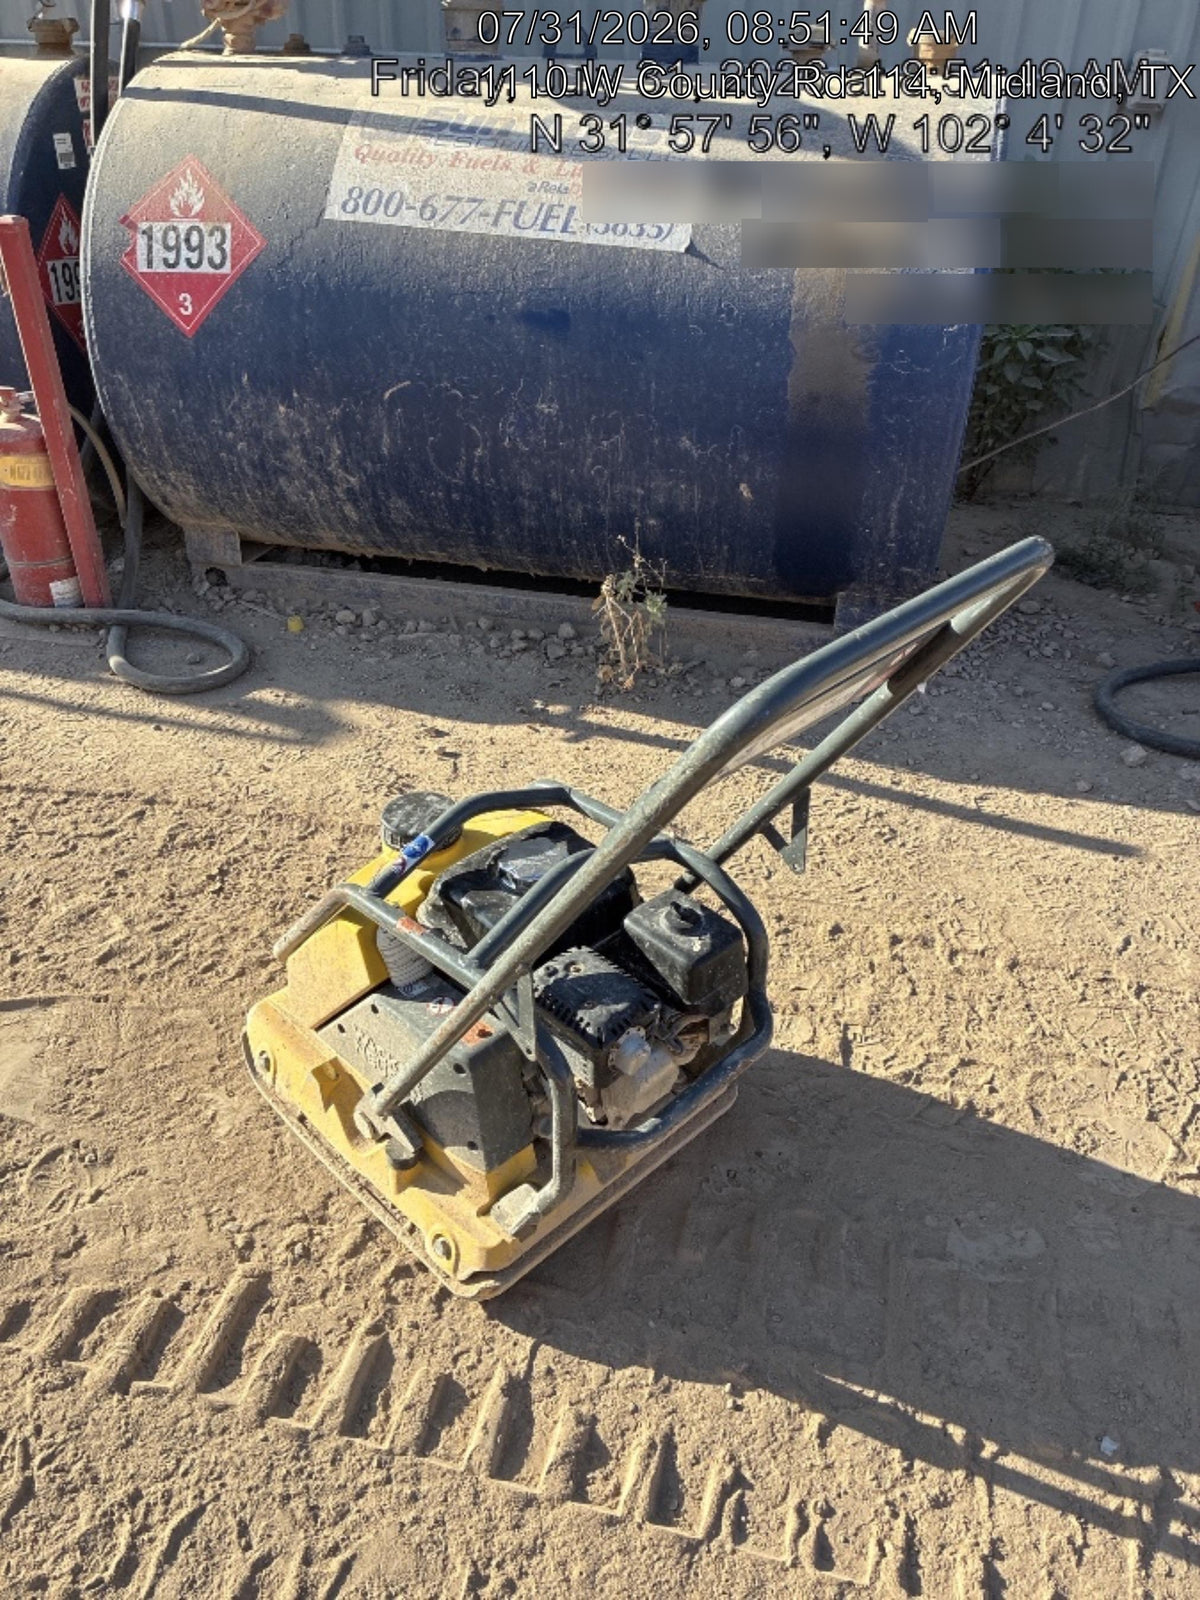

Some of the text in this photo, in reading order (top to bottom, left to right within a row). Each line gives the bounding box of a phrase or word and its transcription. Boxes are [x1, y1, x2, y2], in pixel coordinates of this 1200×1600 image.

[354, 143, 436, 168] Quality
[449, 150, 511, 172] Fuels
[522, 157, 539, 175] &
[340, 186, 577, 234] 800-677-FUEL
[139, 224, 228, 270] 1993
[178, 292, 193, 316] 3
